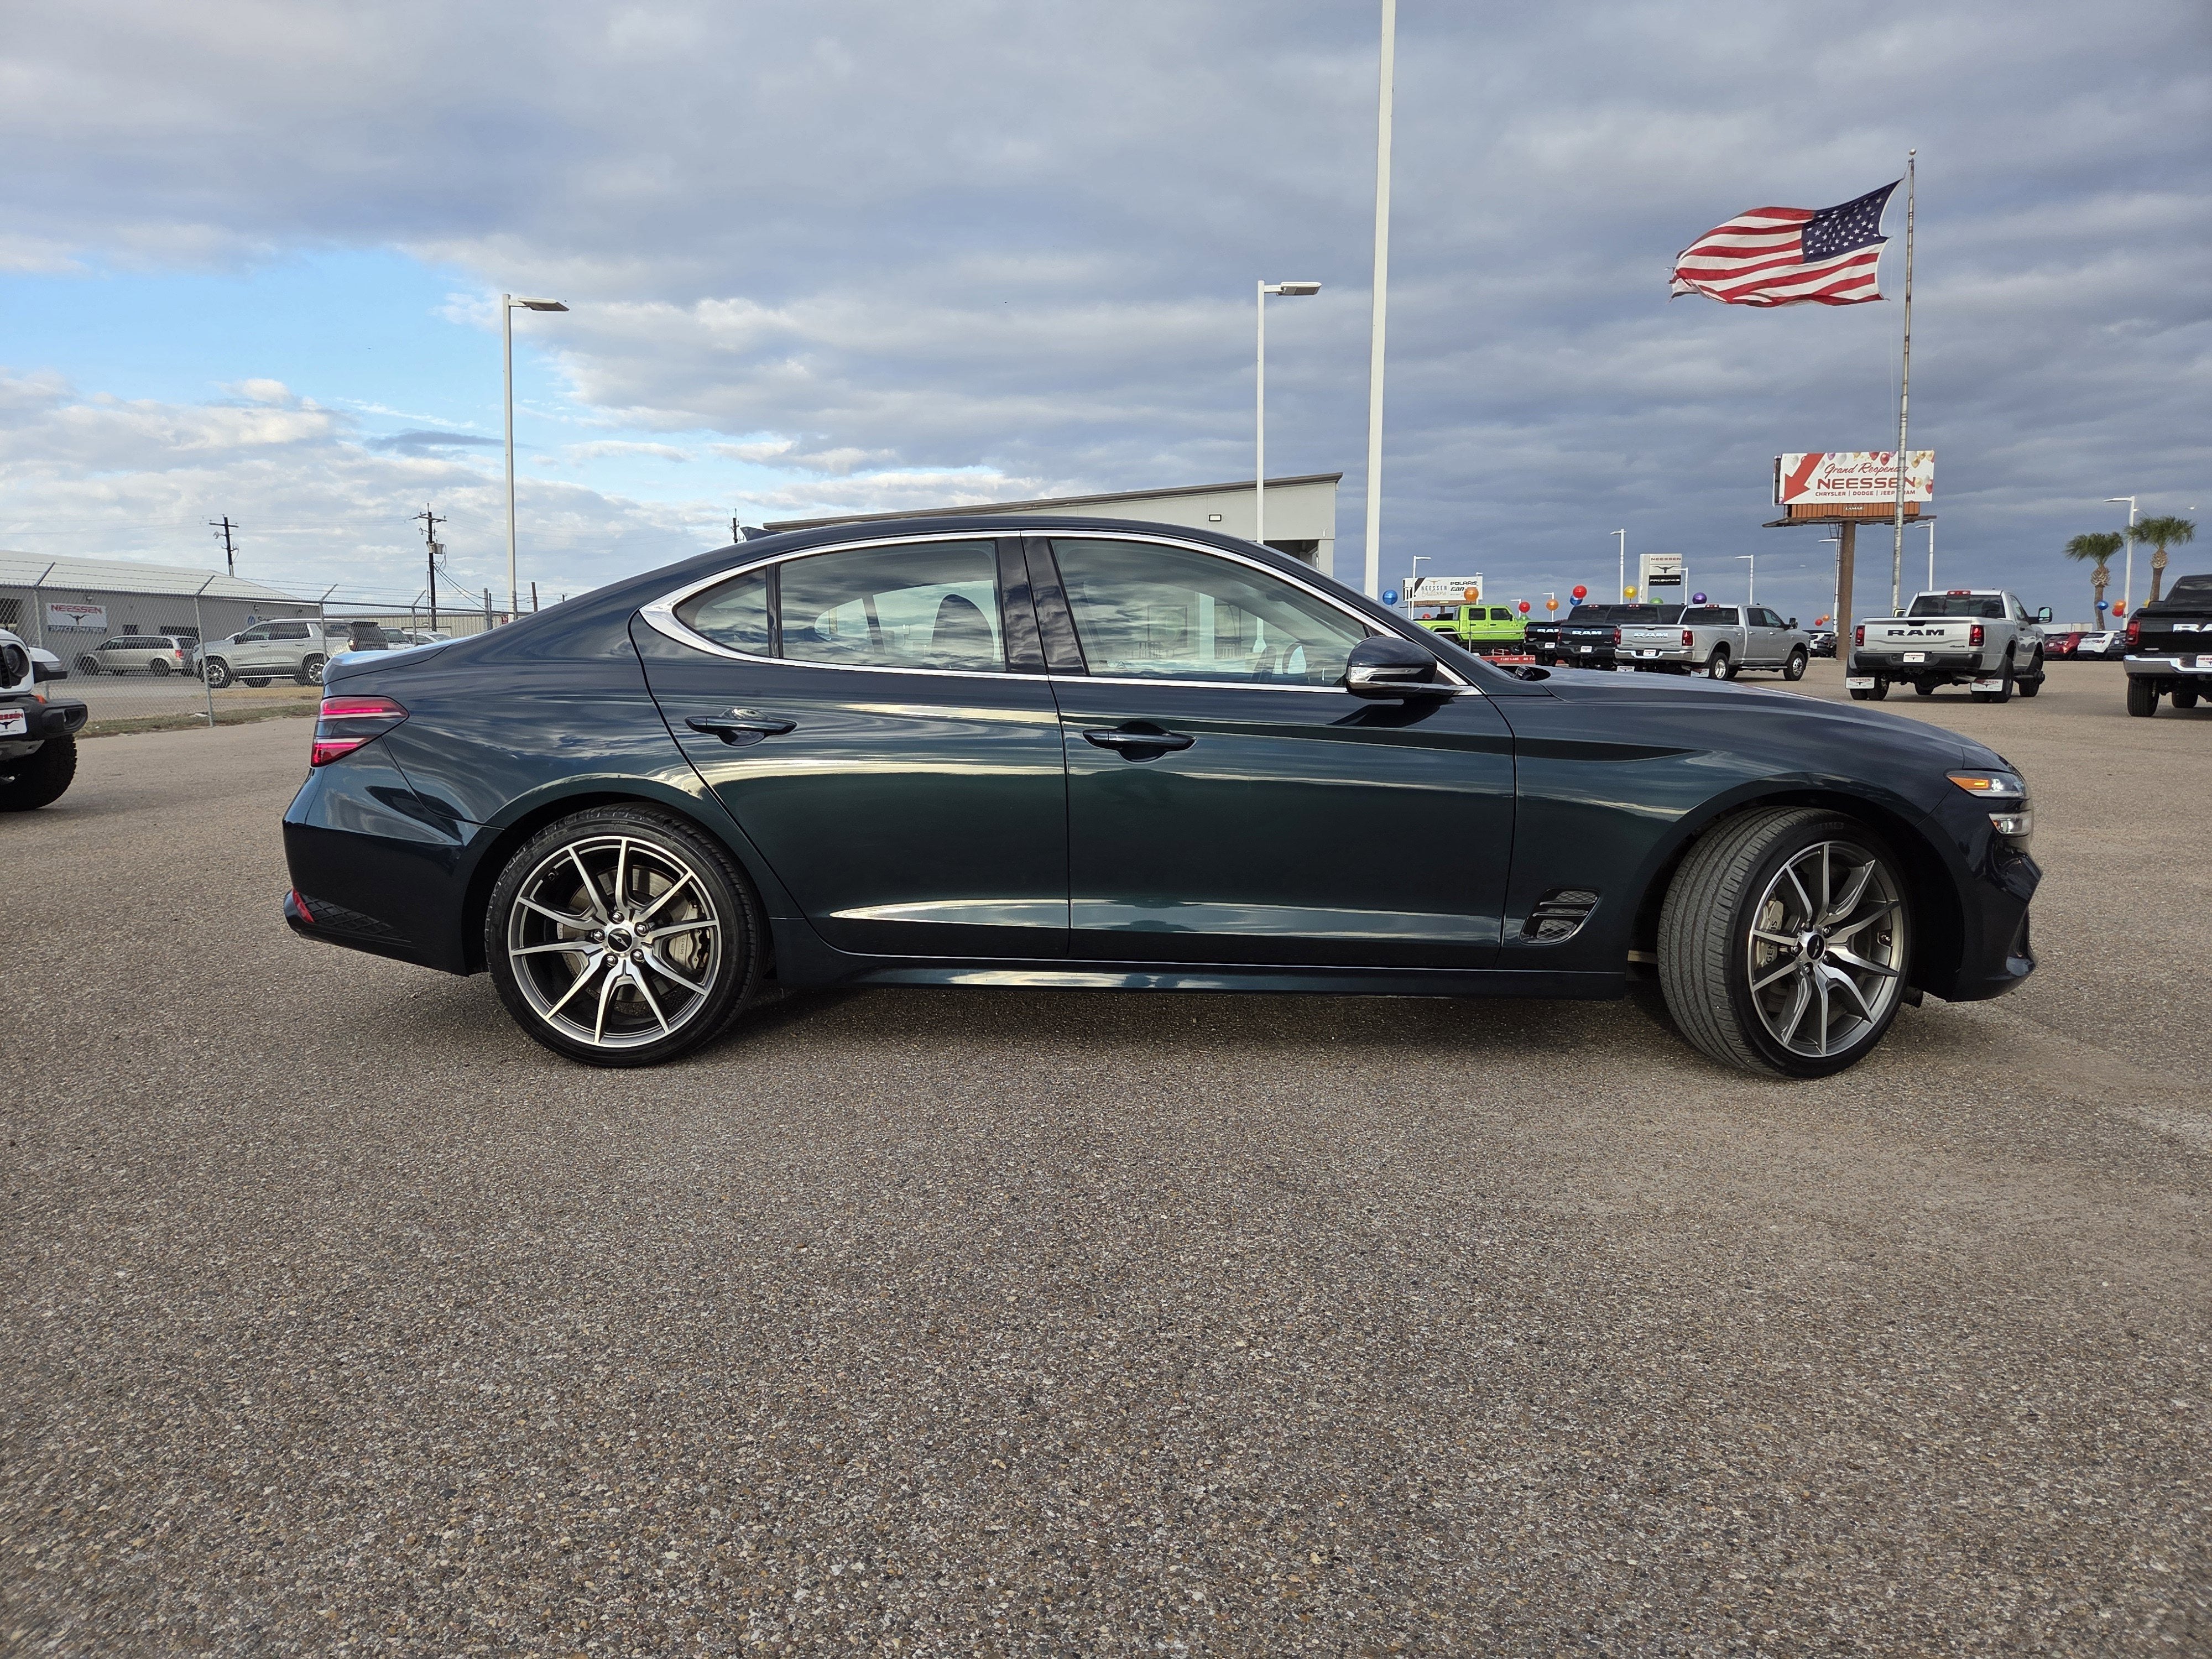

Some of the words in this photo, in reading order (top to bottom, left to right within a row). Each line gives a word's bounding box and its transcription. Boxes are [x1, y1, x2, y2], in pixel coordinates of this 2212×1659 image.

[1824, 463, 1858, 479] Grand
[1817, 477, 1916, 489] NEESSEN
[51, 604, 102, 614] NEESSEN
[1766, 920, 1778, 963] GENIS
